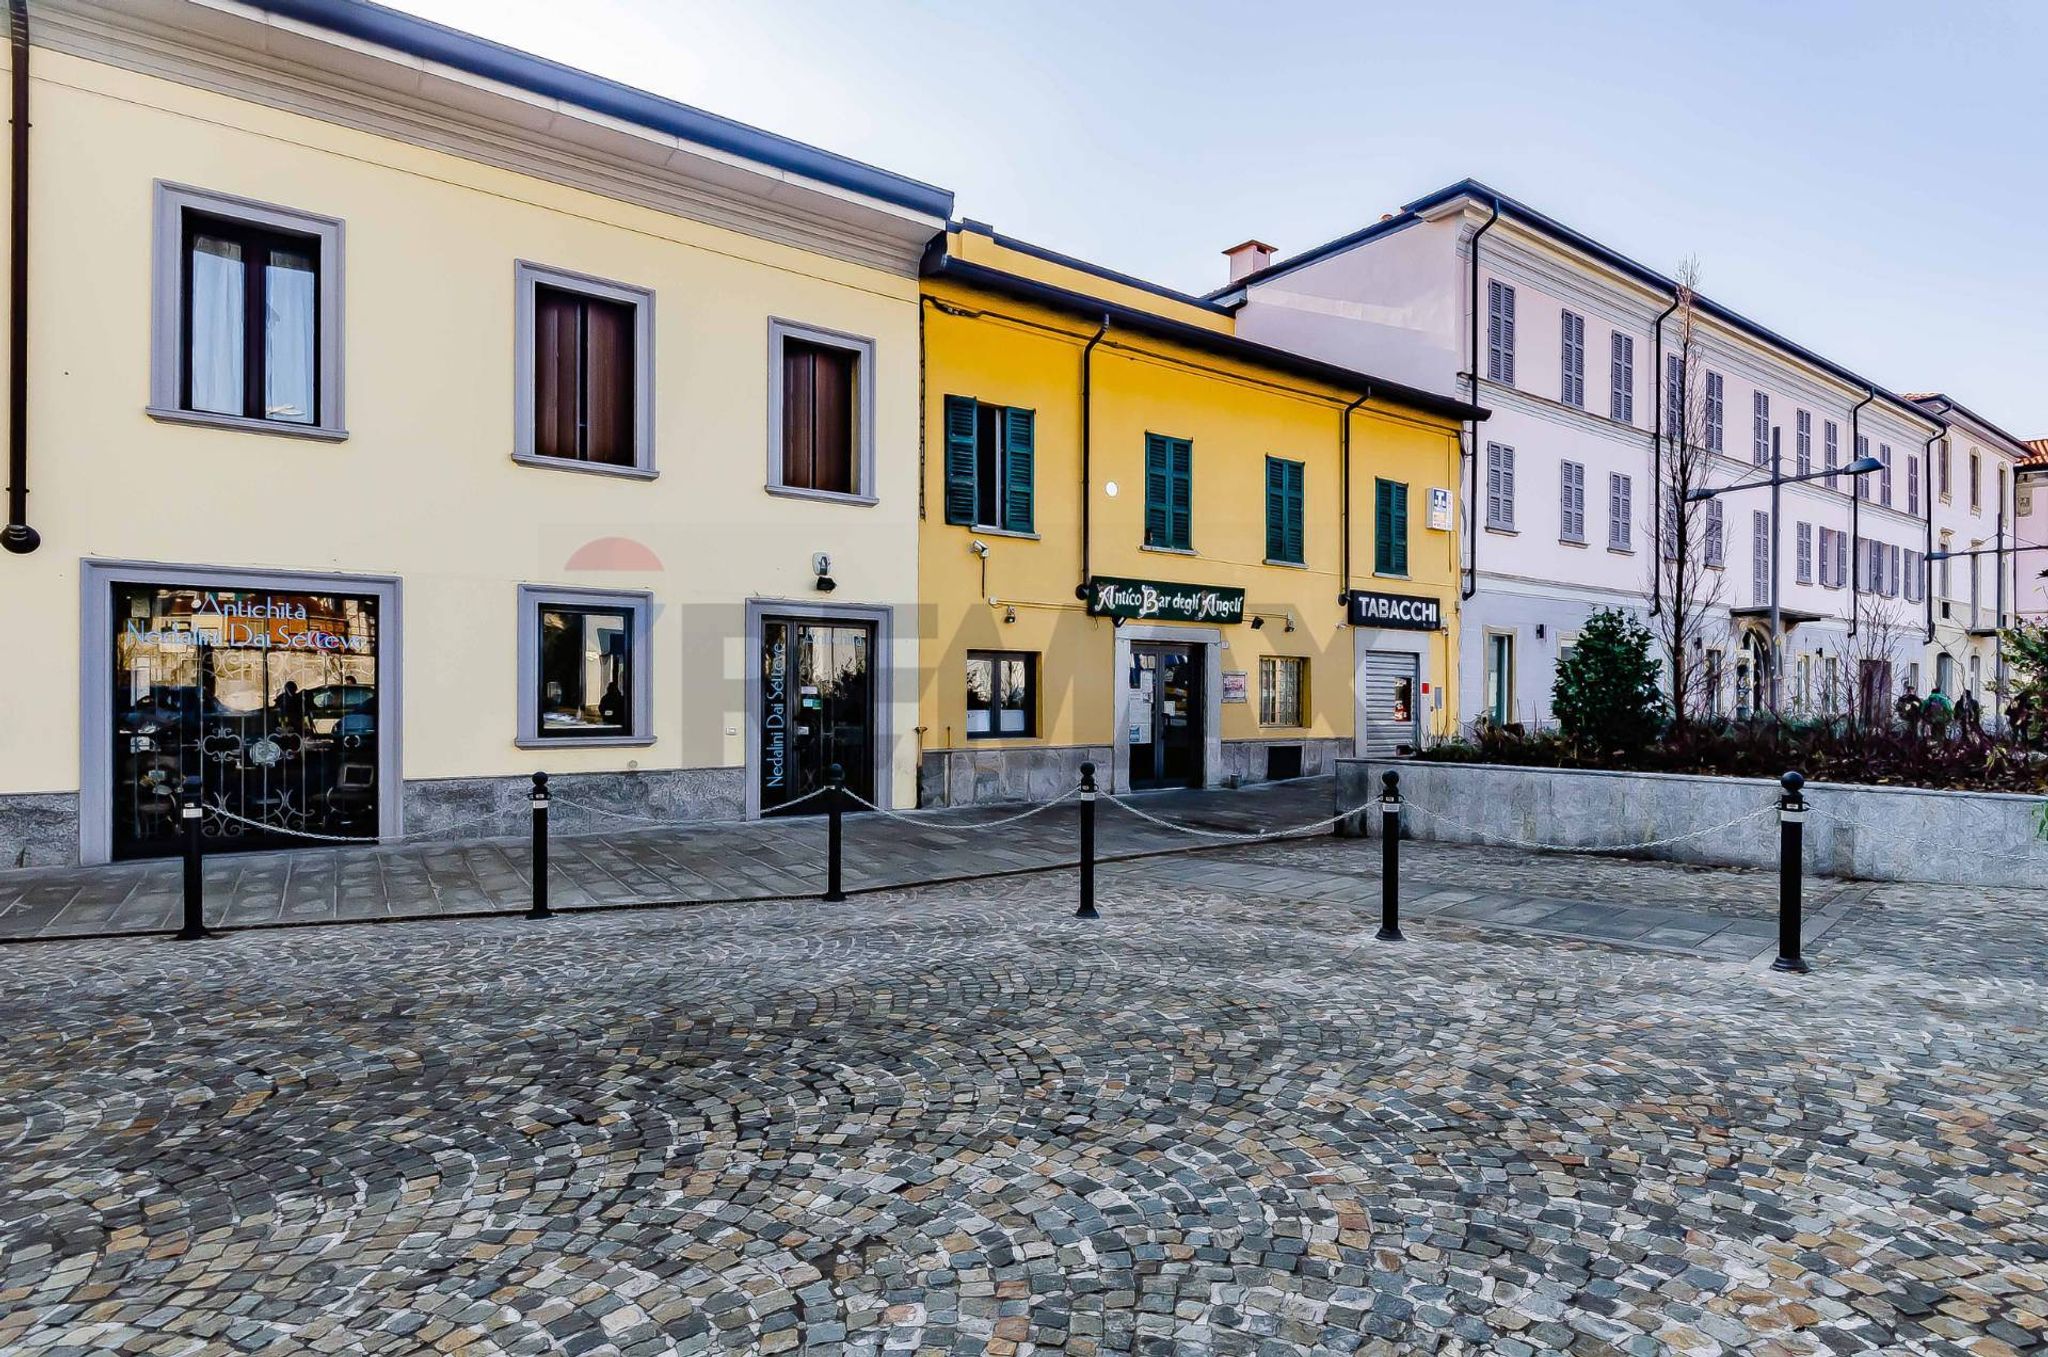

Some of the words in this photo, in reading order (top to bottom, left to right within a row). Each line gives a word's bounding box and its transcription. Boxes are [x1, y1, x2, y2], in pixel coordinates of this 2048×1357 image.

[199, 594, 307, 620] Antichità
[1137, 585, 1170, 618] Bar
[1172, 592, 1200, 615] degli
[1358, 596, 1437, 622] TABACCHI
[766, 703, 784, 728] Dai
[766, 732, 784, 787] Nedalini
